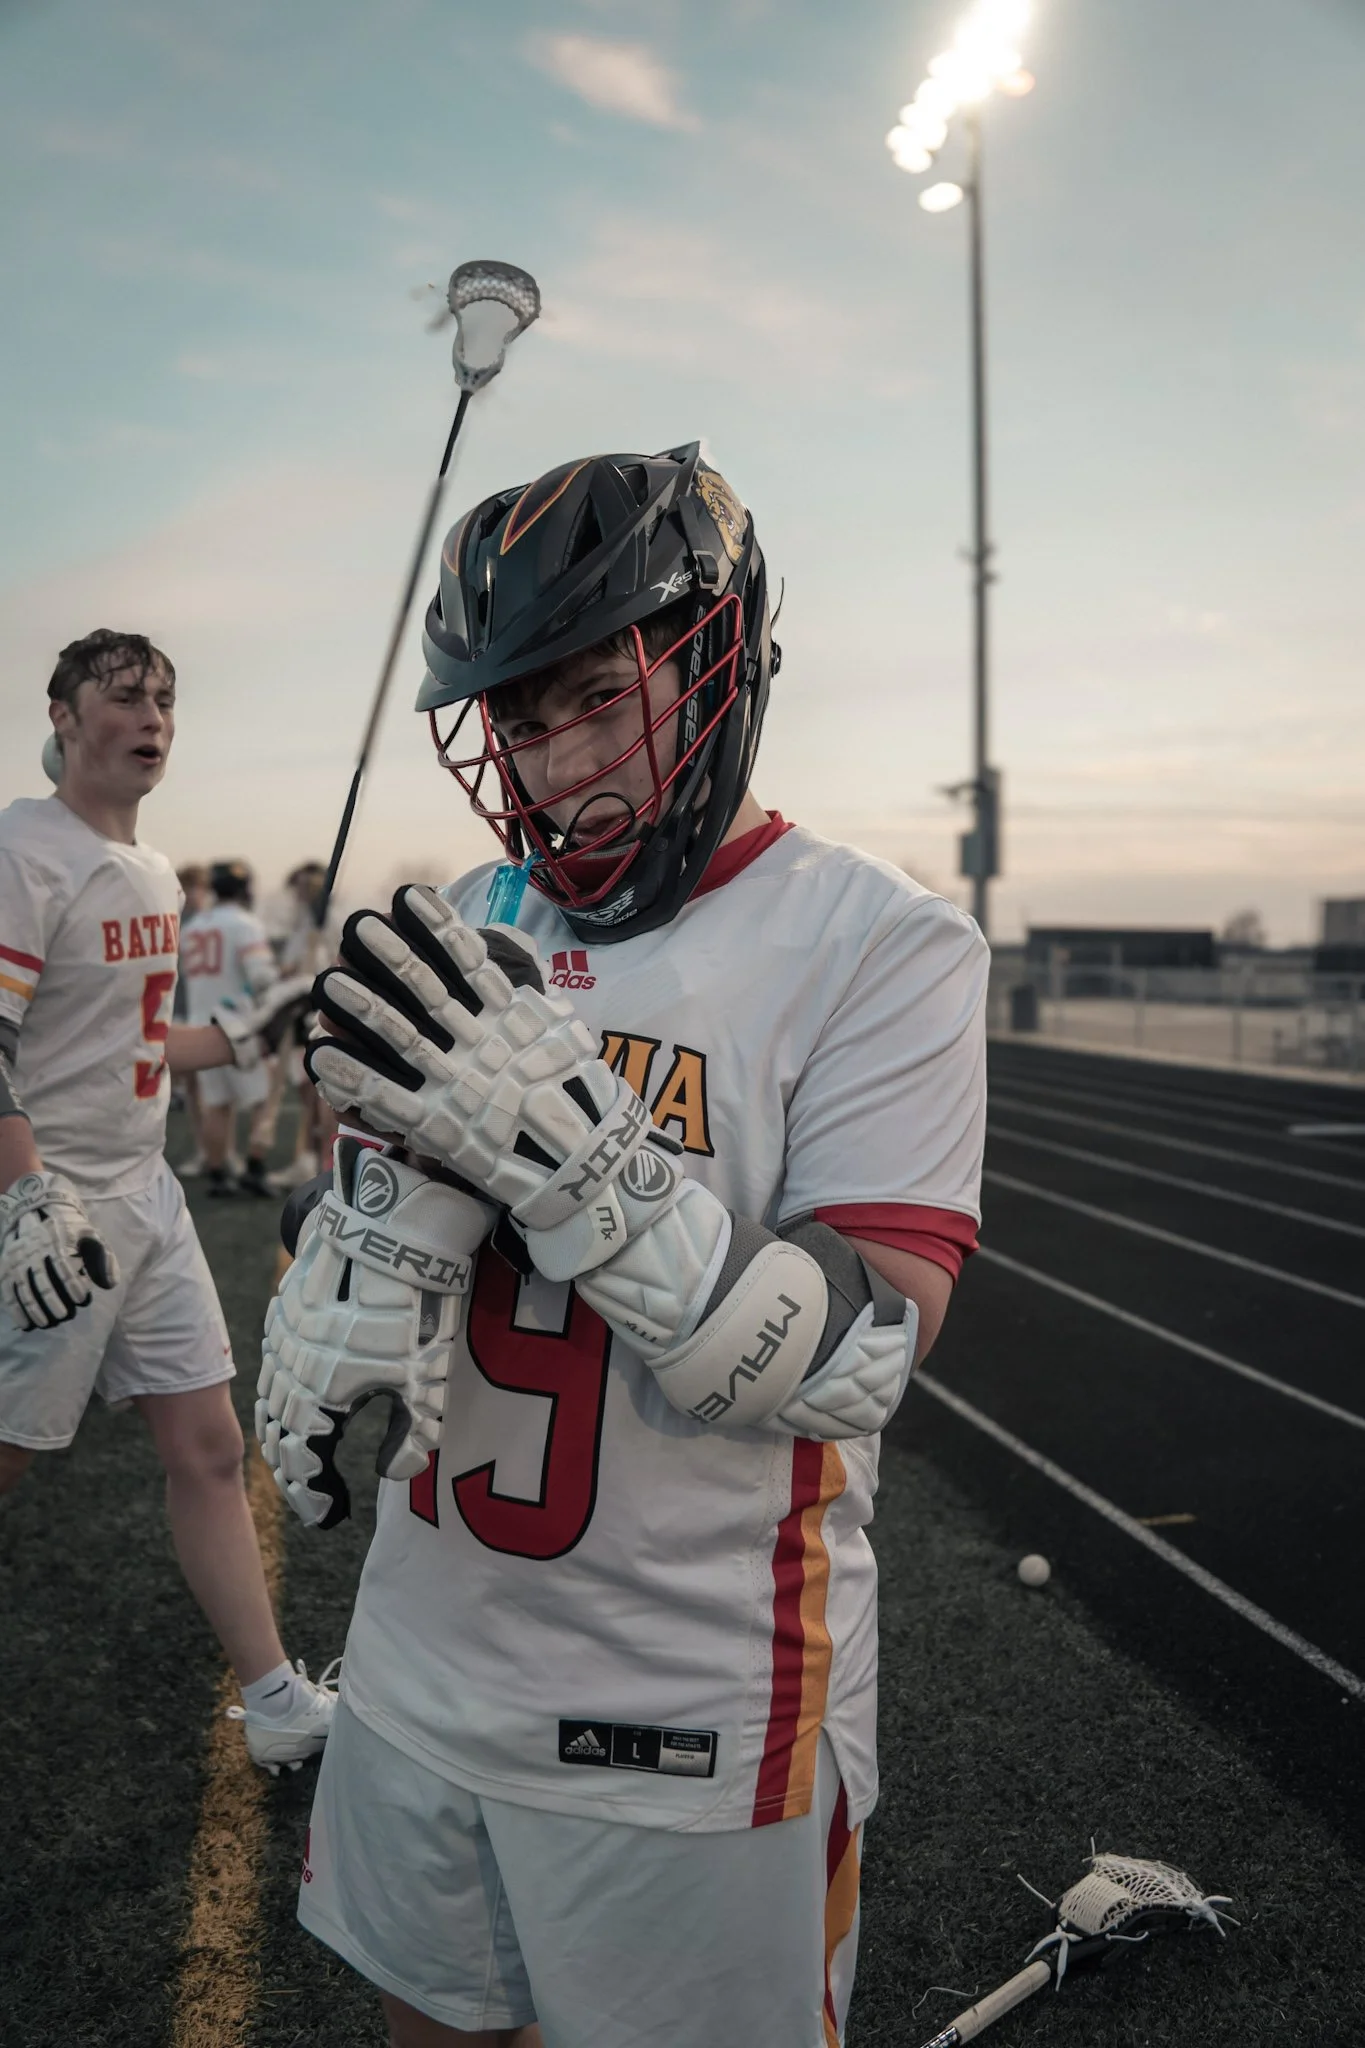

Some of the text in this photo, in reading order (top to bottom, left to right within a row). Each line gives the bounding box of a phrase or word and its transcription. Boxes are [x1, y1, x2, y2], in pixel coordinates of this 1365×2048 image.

[549, 969, 597, 990] das
[565, 1745, 606, 1757] adidas
[632, 1742, 640, 1759] L
